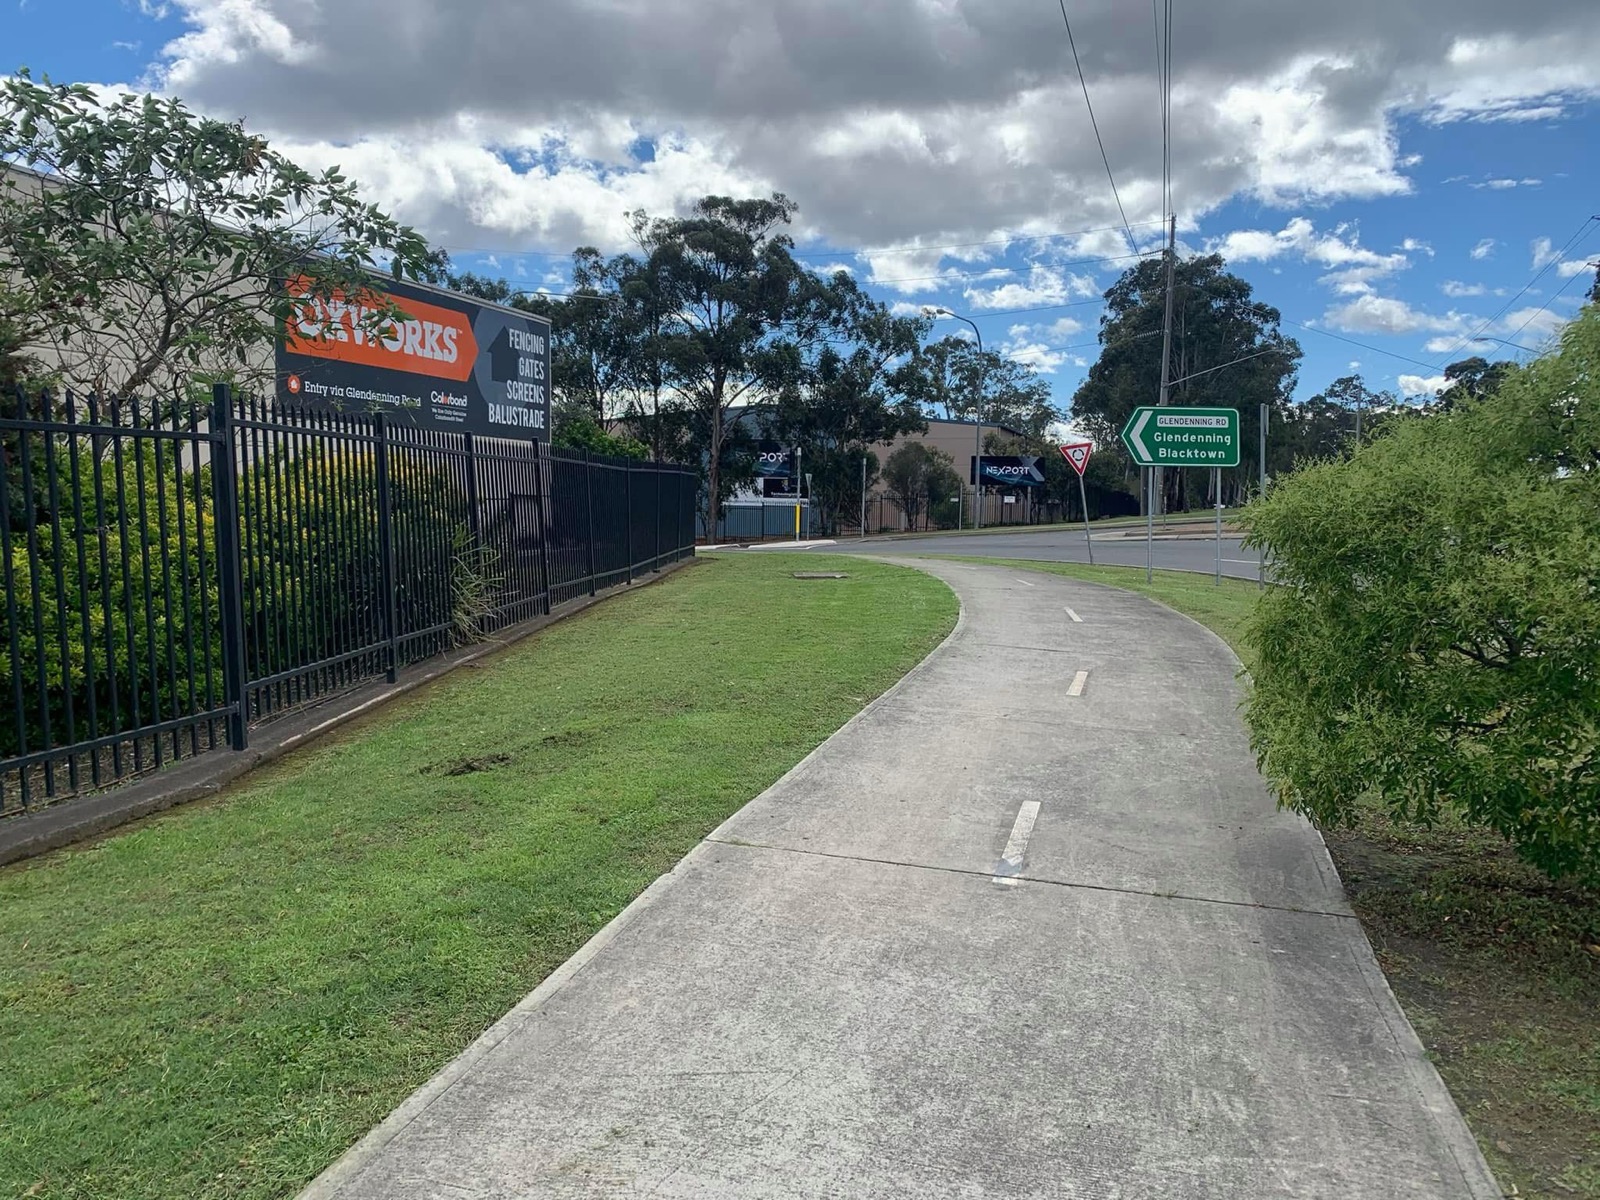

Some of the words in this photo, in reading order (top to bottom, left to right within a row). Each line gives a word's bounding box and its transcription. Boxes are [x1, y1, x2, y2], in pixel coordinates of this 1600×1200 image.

[509, 328, 544, 355] FENCING
[519, 357, 544, 380] GATES
[304, 381, 328, 397] Entry
[330, 386, 344, 397] via
[346, 387, 400, 406] Glendenning
[507, 380, 544, 404] SCREENS
[488, 403, 545, 429] BALUSTRADE
[1159, 417, 1213, 426] GLENDENNING
[1215, 418, 1227, 426] RD
[1154, 432, 1231, 446] Glendenning
[1158, 447, 1226, 459] Blacktown
[986, 465, 1030, 476] NEXPORT
